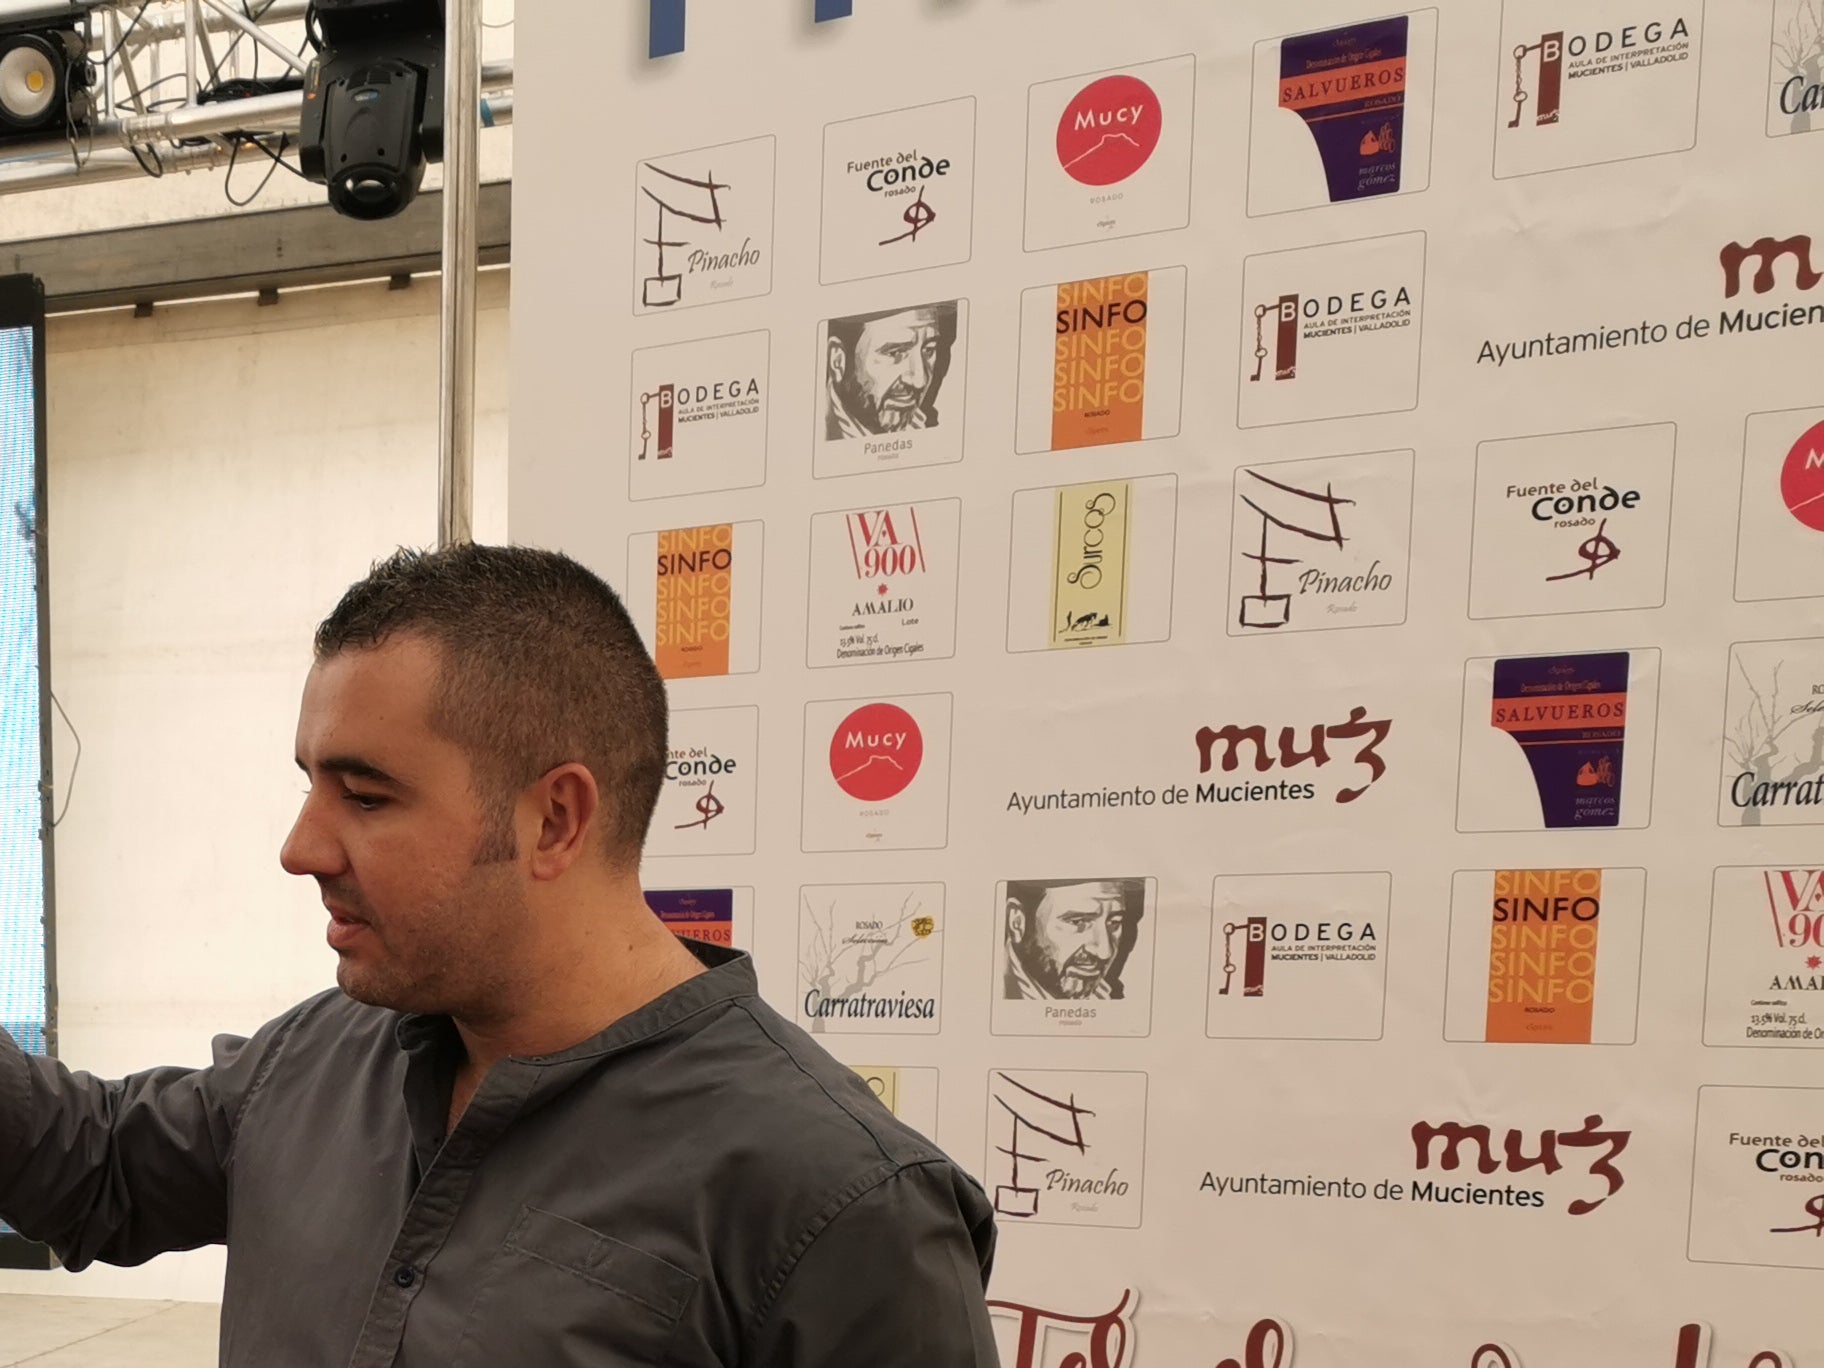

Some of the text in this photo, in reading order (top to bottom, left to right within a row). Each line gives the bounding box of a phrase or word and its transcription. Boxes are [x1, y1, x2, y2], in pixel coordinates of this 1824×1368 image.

[1568, 42, 1689, 69] AULA DE INTERPRETACIÓN
[1568, 51, 1689, 79] MUCIENTES VALLADOLID
[1283, 67, 1404, 102] SALVUEROS
[1075, 104, 1144, 131] Mucy
[847, 149, 918, 174] Fuente del
[867, 156, 951, 192] Conde
[884, 185, 916, 199] rosado
[688, 237, 761, 274] Pinacho
[1058, 272, 1148, 310] SINFO
[1057, 299, 1147, 334] SINFO
[1304, 308, 1411, 329] AULA DE INTERPRETACIÓN
[1304, 318, 1411, 339] MUCIENTES VALLADOLID
[1056, 326, 1146, 360] SINFO
[1476, 320, 1668, 367] Ayuntamiento
[1676, 314, 1711, 340] de
[1054, 352, 1144, 387] SINFO
[1053, 379, 1143, 412] SINFO
[678, 406, 760, 424] MUCIENTES VALLADOLID
[864, 438, 913, 455] Panedas
[1506, 477, 1599, 499] Fuente del
[1531, 486, 1641, 522] Conde
[852, 510, 904, 547] VA
[1554, 516, 1596, 529] rosado
[658, 525, 731, 552] SINFO
[1067, 493, 1116, 589] Surcos
[657, 549, 732, 575] SINFO
[864, 545, 916, 578] 900
[656, 572, 731, 599] SINFO
[1298, 560, 1392, 595] Pinacho
[656, 596, 730, 623] SINFO
[852, 598, 914, 617] AMALIO
[656, 619, 729, 647] SINFO
[902, 618, 919, 626] Lote
[1496, 702, 1624, 723] SALVUEROS
[689, 746, 707, 758] del
[845, 730, 907, 751] Mucy
[665, 754, 736, 780] Conde
[1007, 780, 1316, 815] Ayuntamiento de Mucientes
[1495, 870, 1601, 896] SINFO
[1493, 897, 1600, 922] SINFO
[856, 921, 883, 929] ROSADO
[1492, 924, 1598, 950] SINFO
[1271, 953, 1376, 961] MUCIENTES VALLADOLID
[1308, 943, 1376, 951] INTERPRETACIÓN
[1491, 951, 1596, 977] SINFO
[804, 988, 935, 1019] Carratraviesa
[1489, 978, 1595, 1004] SINFO
[1045, 1006, 1097, 1018] Panedas
[1746, 1026, 1813, 1039] Denominación de
[1729, 1133, 1792, 1147] Fuente
[1046, 1168, 1129, 1197] Pinacho
[1199, 1171, 1545, 1208] Ayuntamiento de Mucientes
